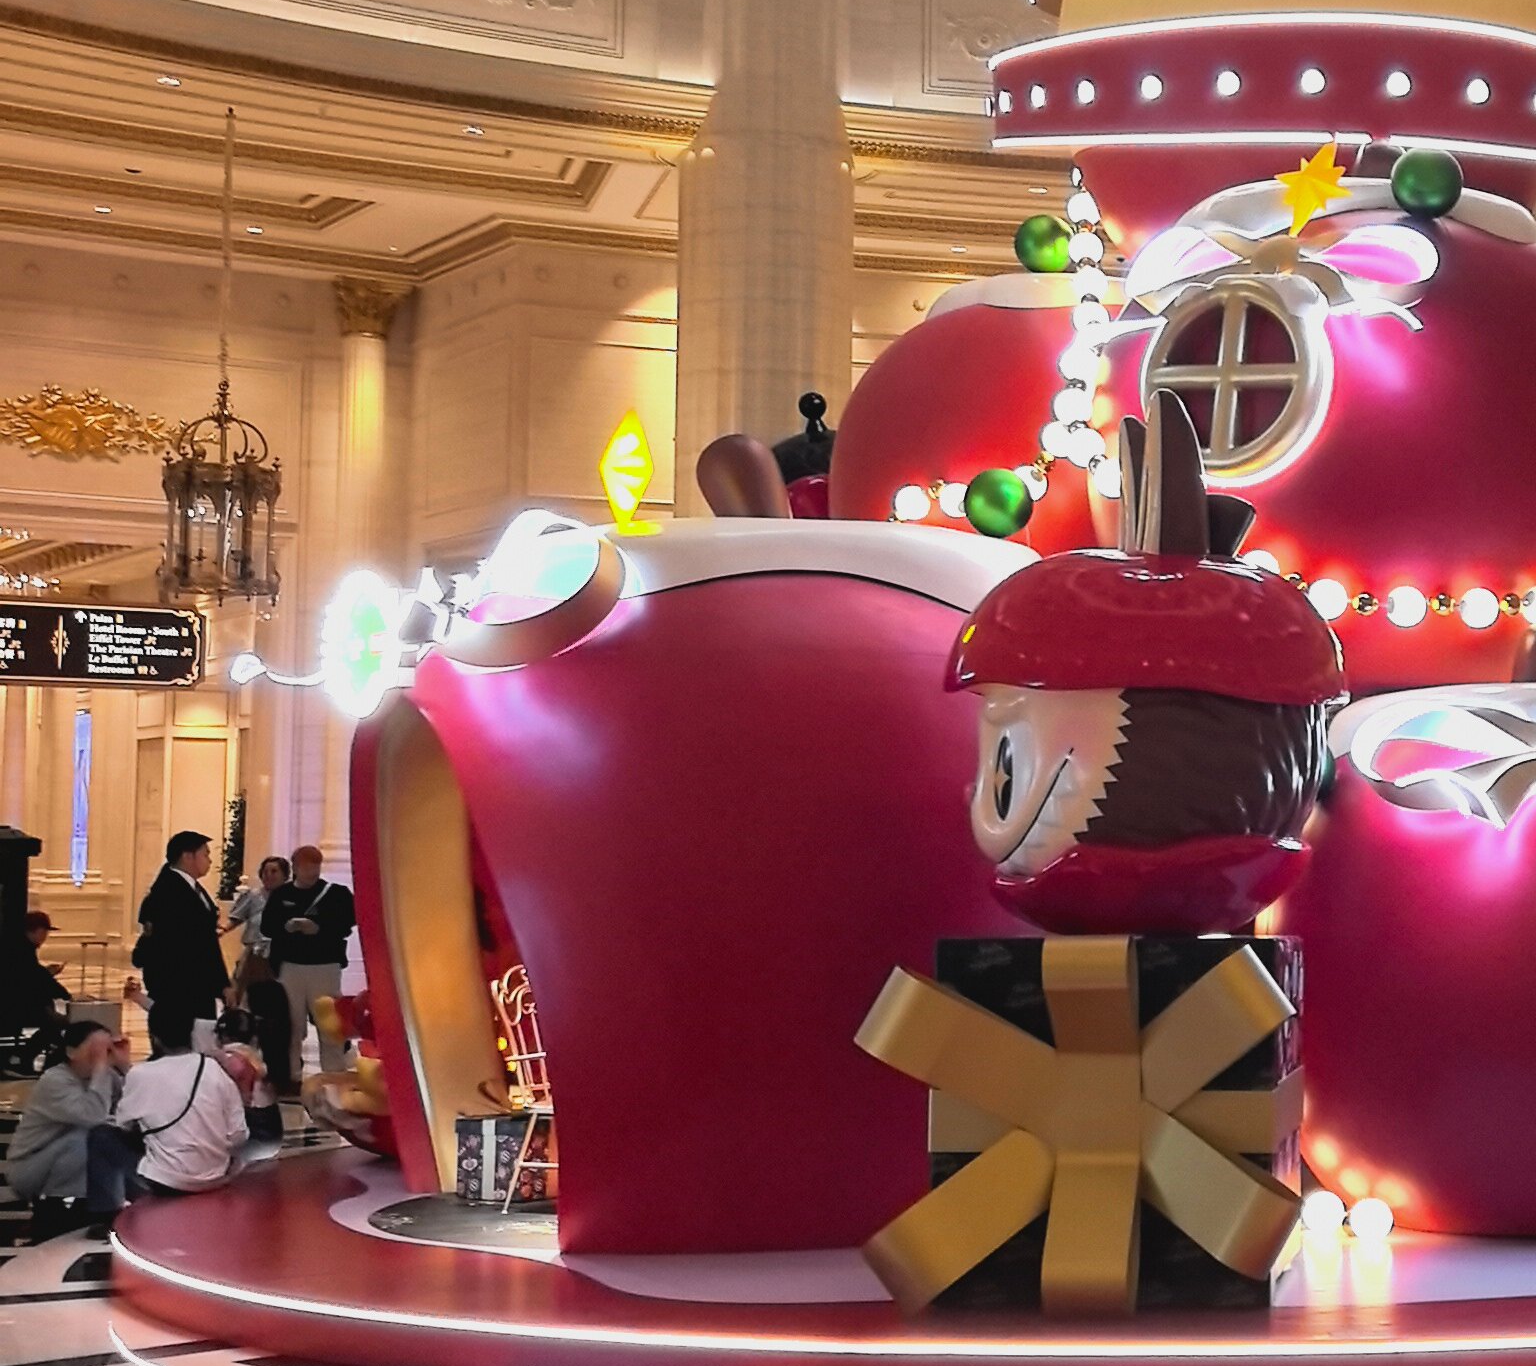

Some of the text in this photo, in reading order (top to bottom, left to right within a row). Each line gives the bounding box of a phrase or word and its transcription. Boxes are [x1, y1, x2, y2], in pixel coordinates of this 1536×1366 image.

[89, 623, 114, 635] Hotel
[115, 625, 147, 636] Rooms
[153, 626, 180, 637] South
[89, 634, 142, 646] Eiffel Tower
[88, 644, 107, 654] The
[108, 645, 144, 655] Parisian
[88, 654, 100, 663] Le
[88, 664, 135, 675] Restrooms
